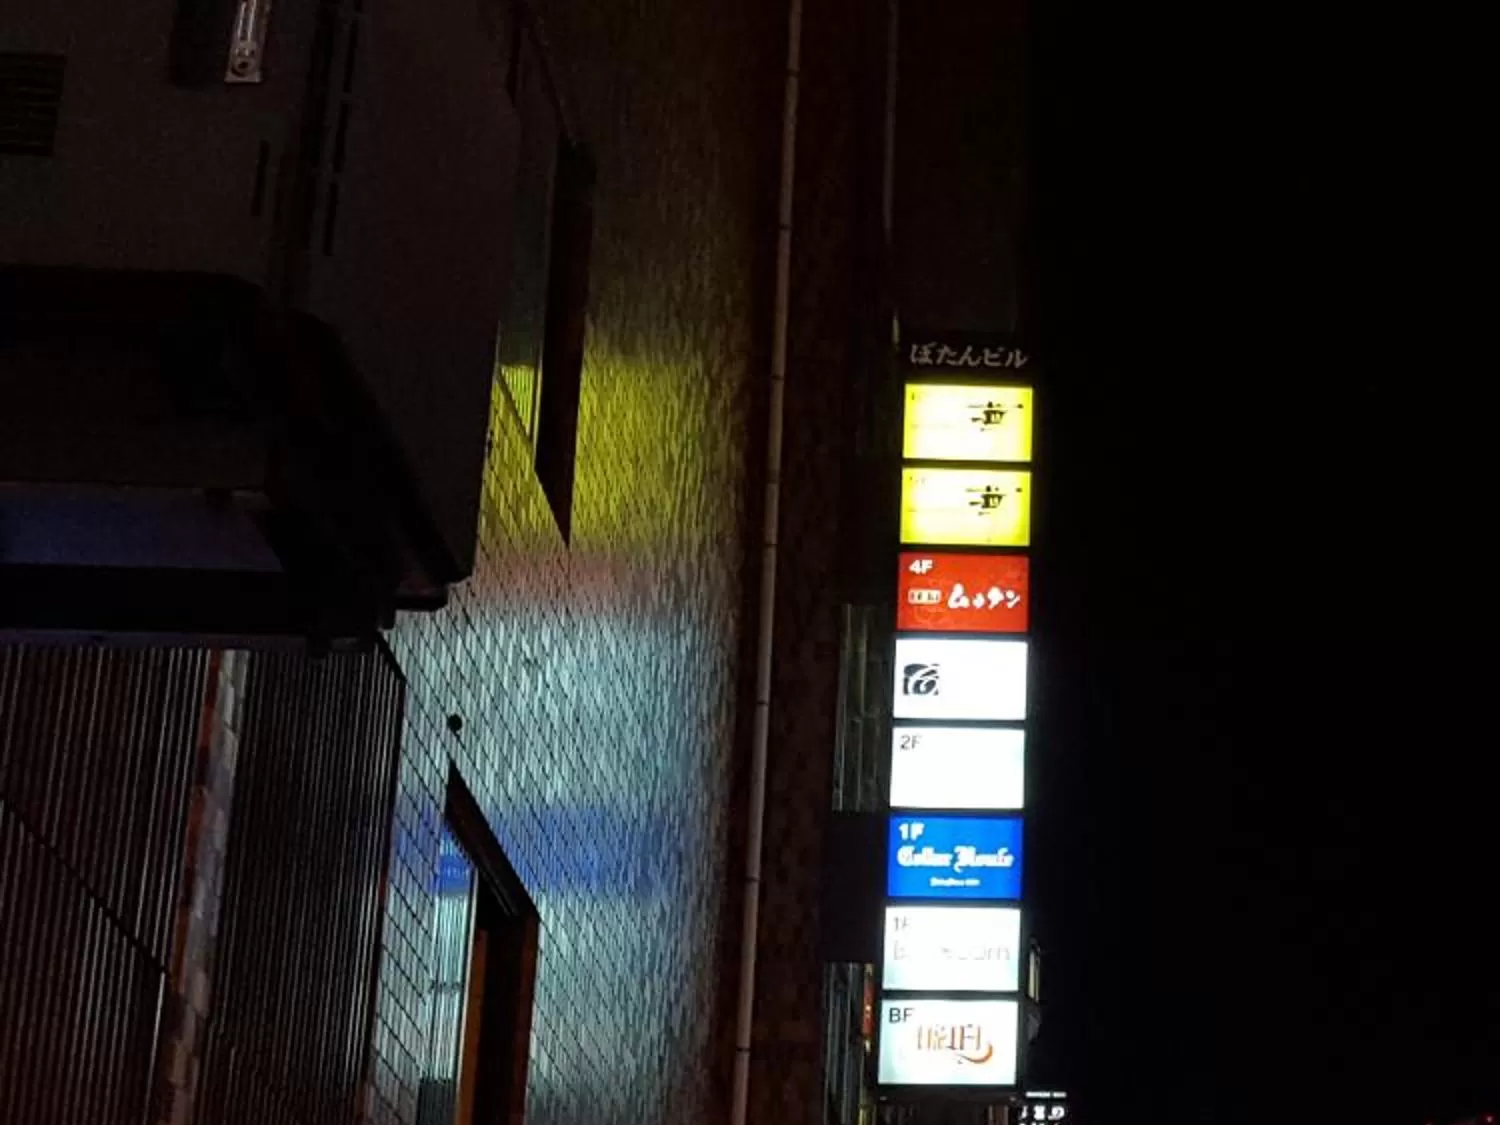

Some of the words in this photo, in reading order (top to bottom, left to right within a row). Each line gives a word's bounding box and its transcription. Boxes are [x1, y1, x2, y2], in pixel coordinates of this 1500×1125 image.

[910, 341, 1028, 368] ぼたんビル
[909, 559, 933, 574] 4F
[898, 823, 925, 840] 1F
[889, 1007, 913, 1023] BF
